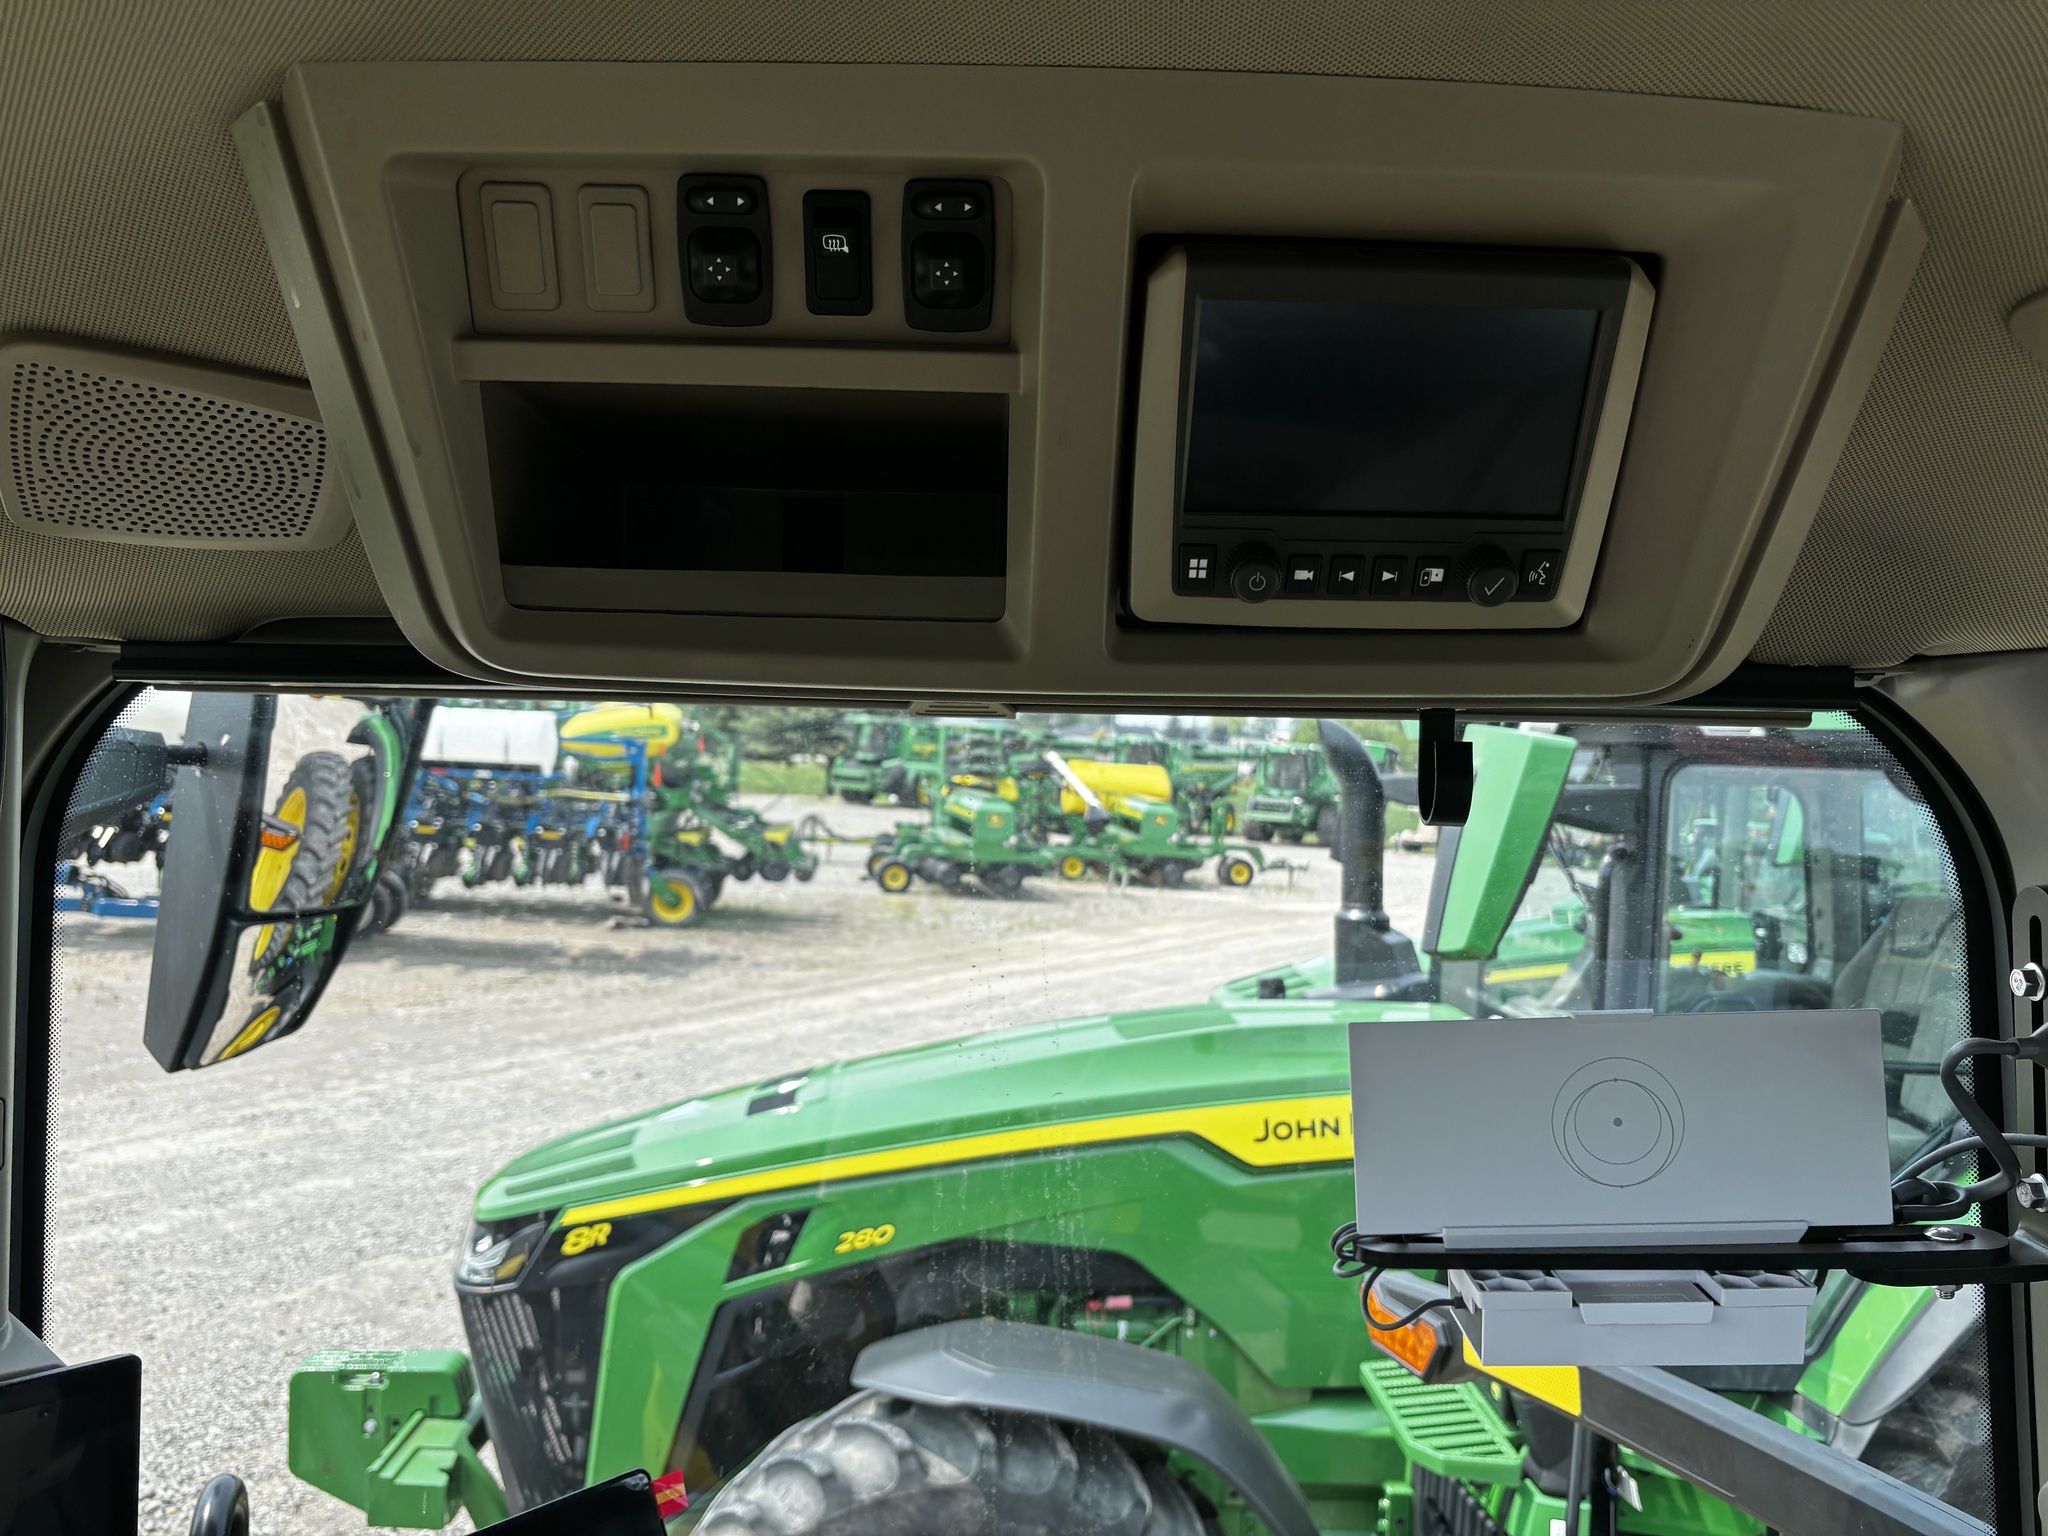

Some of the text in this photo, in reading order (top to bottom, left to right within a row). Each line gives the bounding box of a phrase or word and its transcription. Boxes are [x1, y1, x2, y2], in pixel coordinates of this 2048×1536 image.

[1253, 1117, 1340, 1143] JOHN
[560, 1222, 612, 1256] 8R
[833, 1223, 896, 1254] 280
